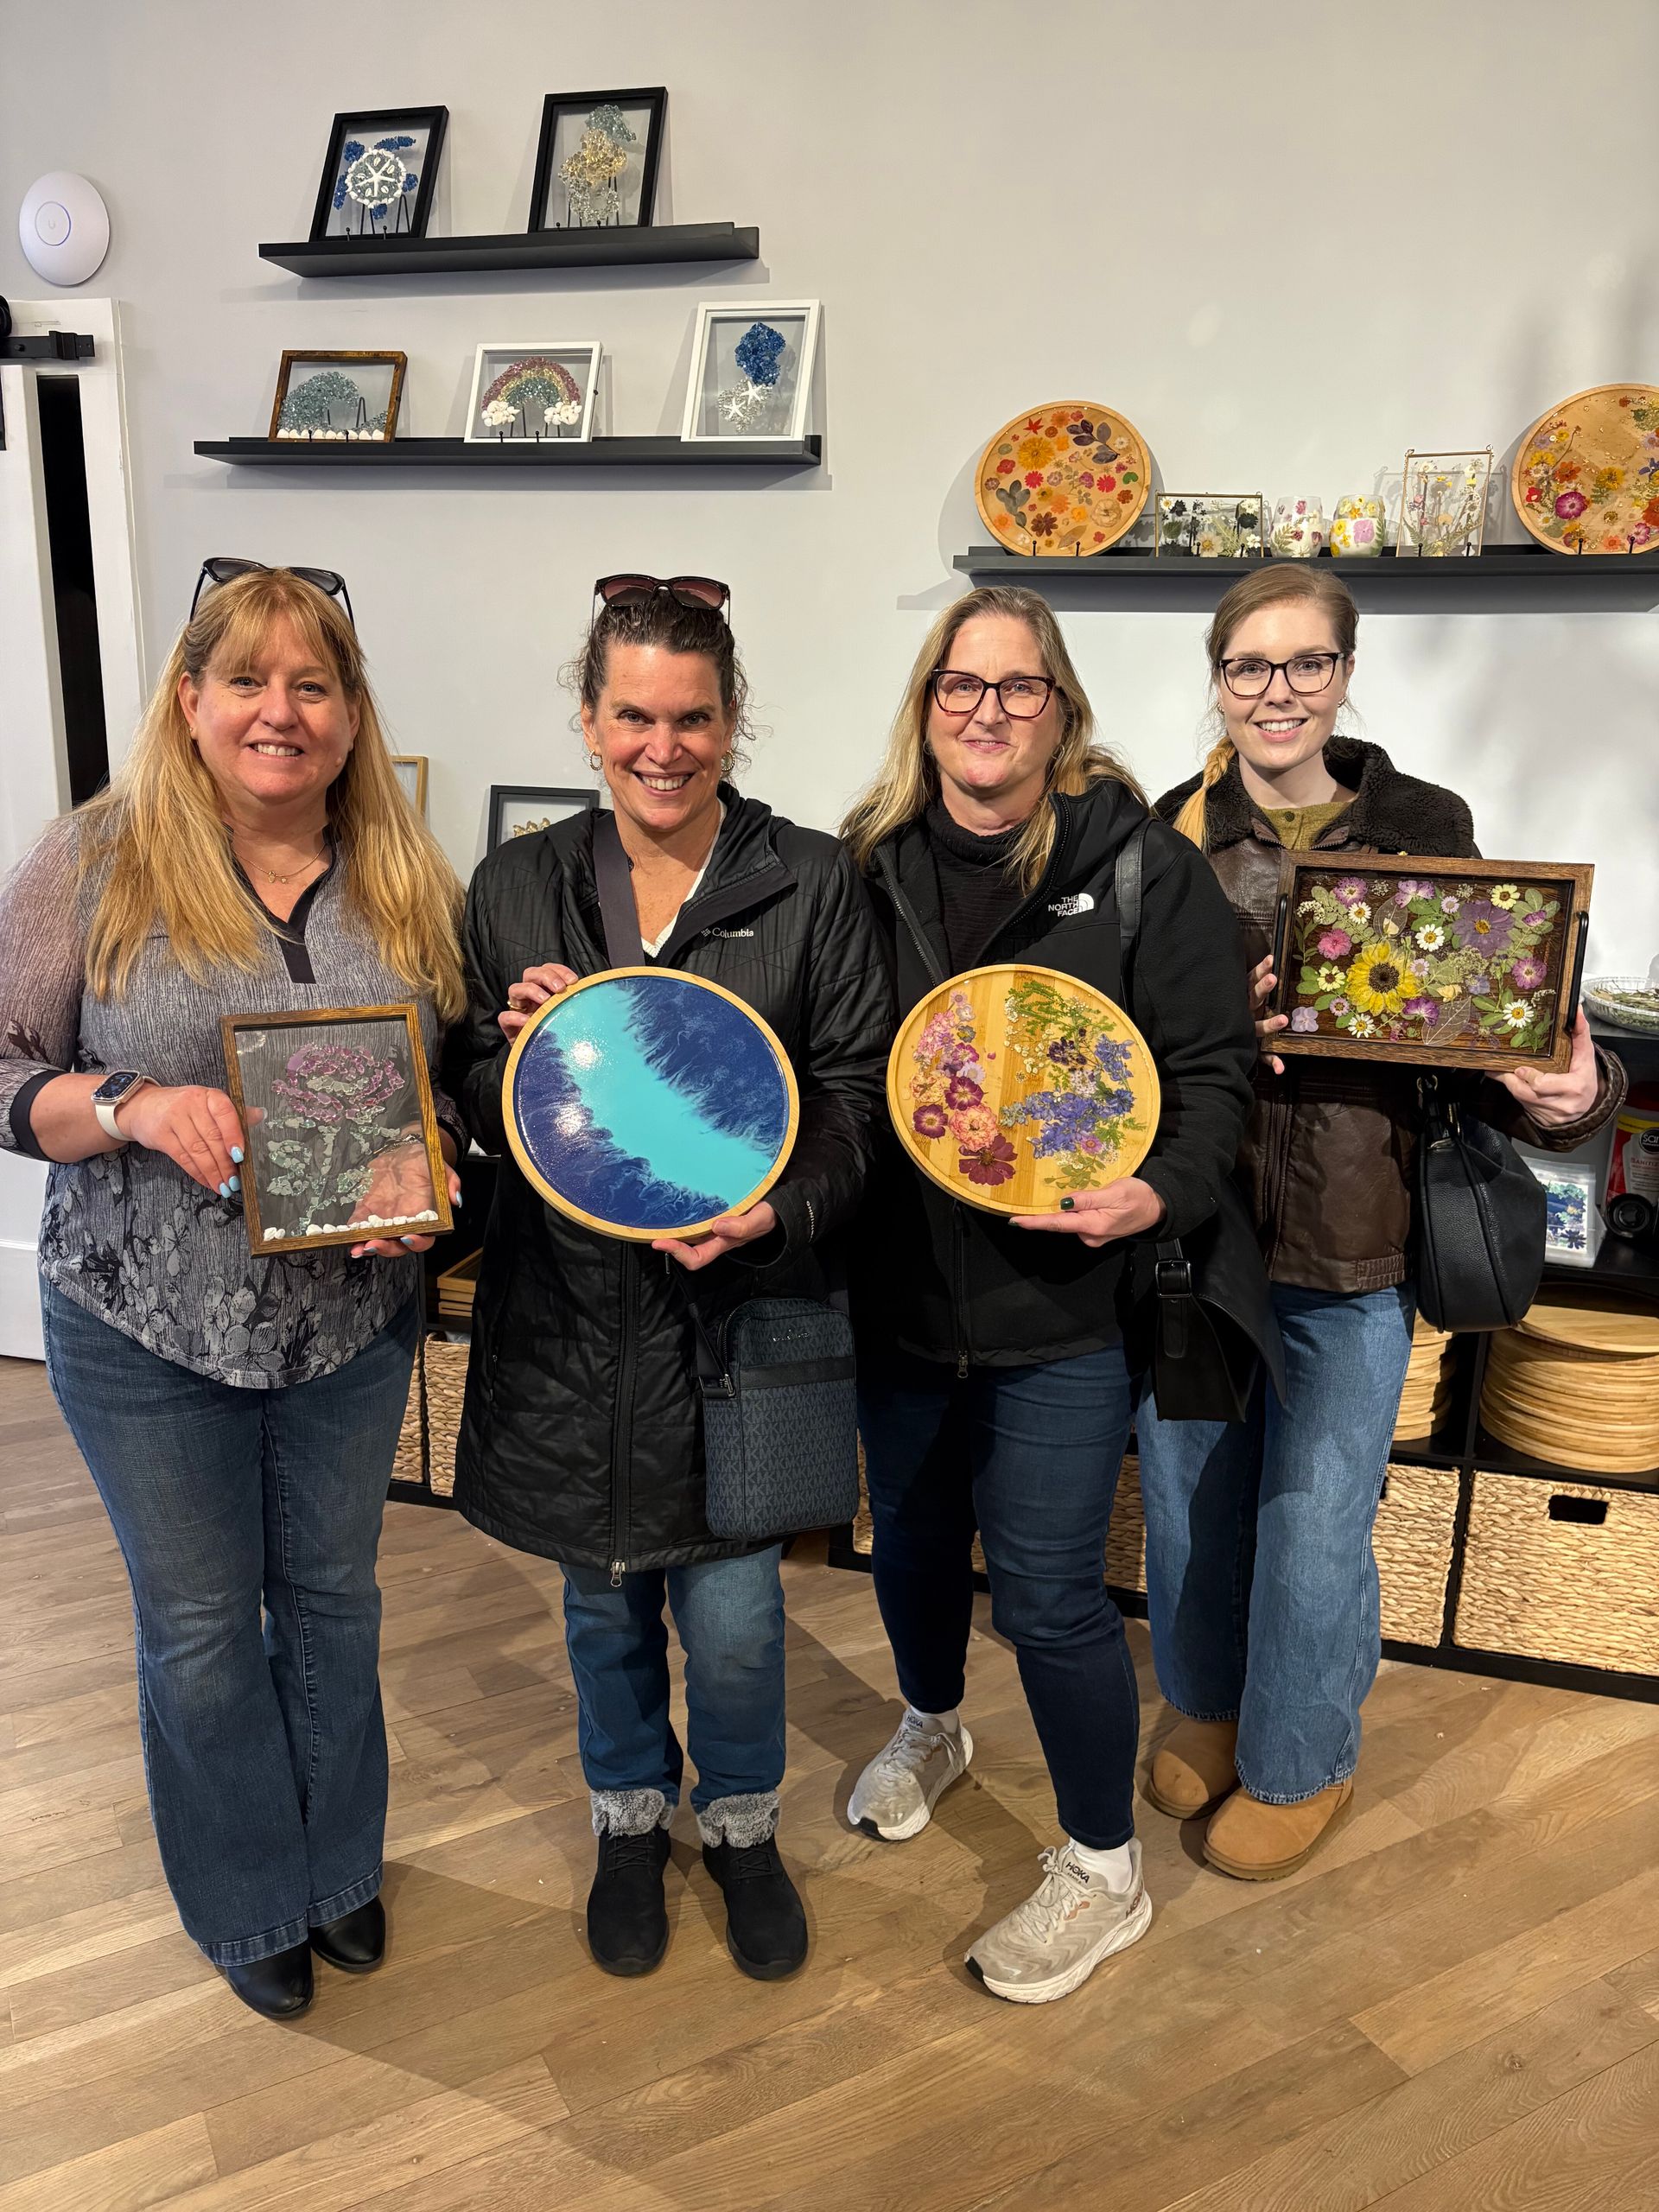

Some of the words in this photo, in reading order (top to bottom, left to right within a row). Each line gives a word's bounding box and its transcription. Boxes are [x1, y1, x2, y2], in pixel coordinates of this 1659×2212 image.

[1061, 894, 1078, 903] THE
[1047, 899, 1079, 912] NORTH
[1057, 908, 1078, 917] FACE
[712, 927, 754, 939] Columbia
[906, 1714, 924, 1728] HOKA
[1065, 1861, 1090, 1884] HOKA
